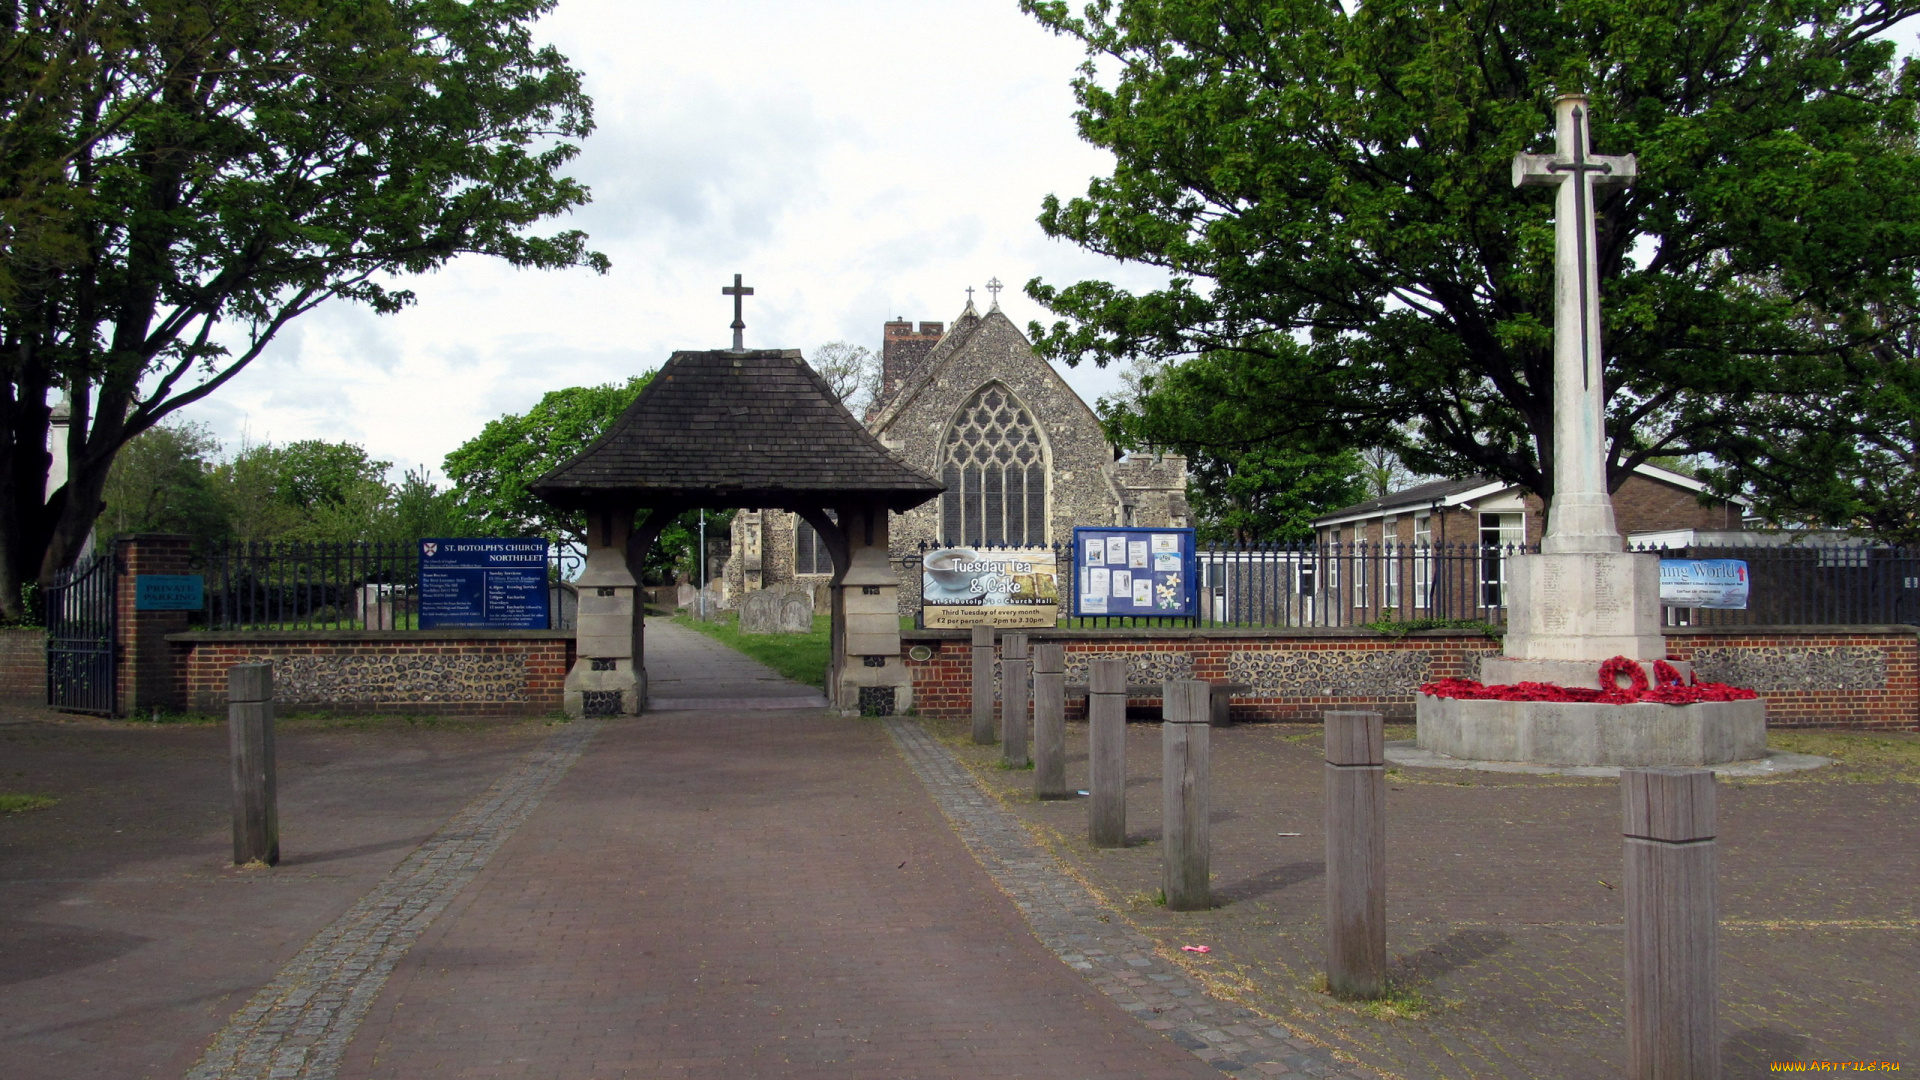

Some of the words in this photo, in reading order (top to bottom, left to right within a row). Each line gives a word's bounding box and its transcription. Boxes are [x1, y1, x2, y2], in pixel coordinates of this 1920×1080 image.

[444, 544, 456, 552] ST.
[457, 544, 504, 552] BOTOLPH'S
[505, 544, 543, 552] CHURCH
[489, 554, 544, 562] NORTHFLEET
[951, 558, 1005, 577] Tuesday
[1008, 558, 1032, 573] Tea
[1692, 563, 1736, 578] World
[970, 578, 983, 593] &
[986, 578, 1020, 593] Cake
[144, 593, 197, 601] PARKING
[961, 609, 988, 617] Tuesday
